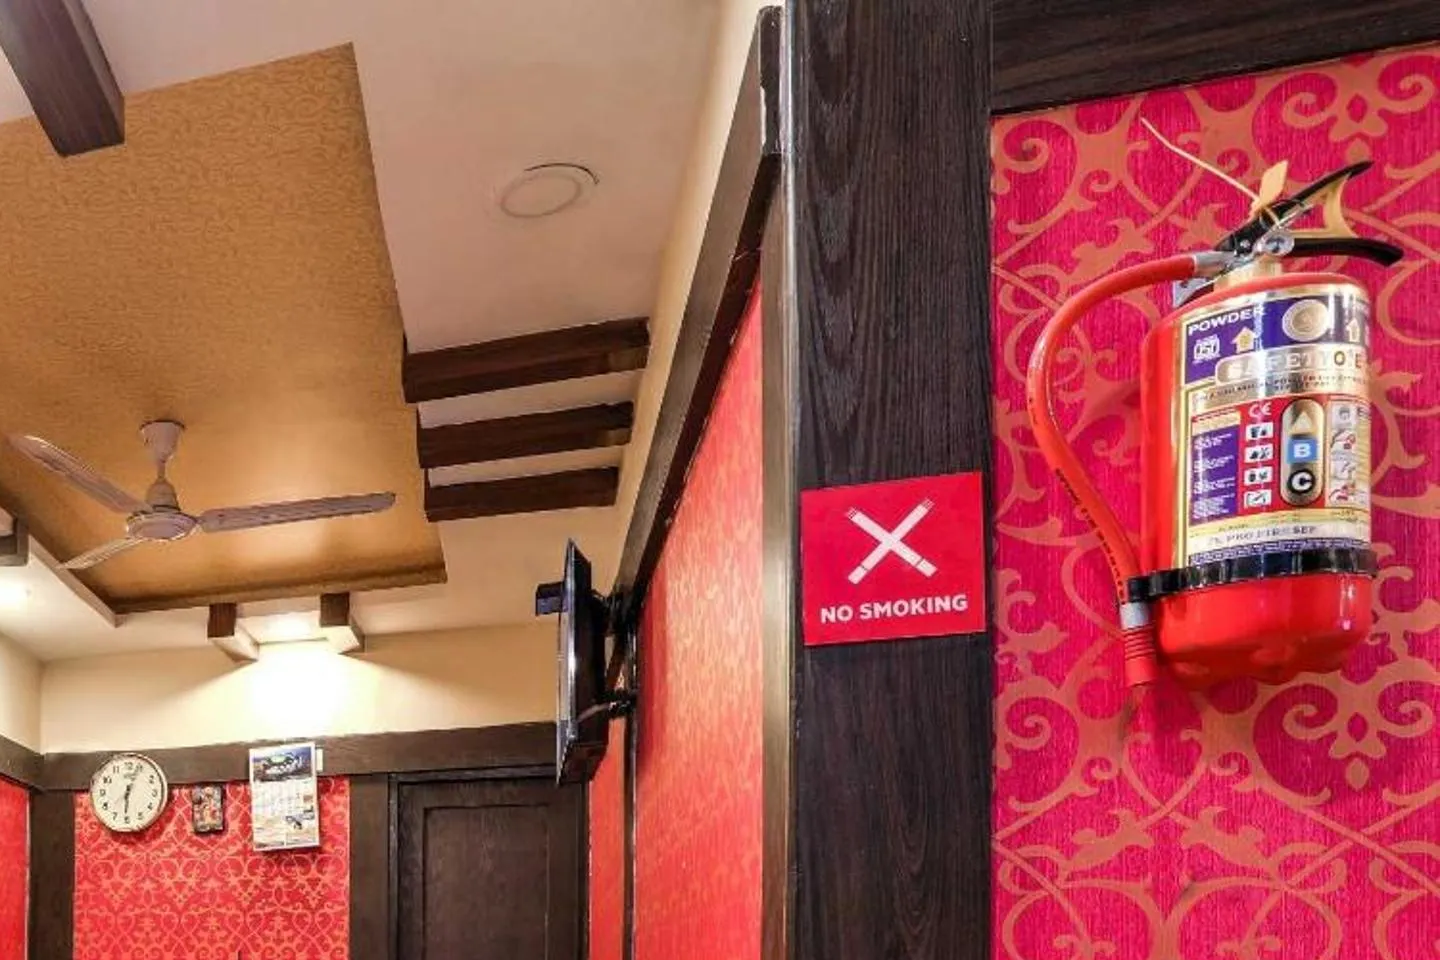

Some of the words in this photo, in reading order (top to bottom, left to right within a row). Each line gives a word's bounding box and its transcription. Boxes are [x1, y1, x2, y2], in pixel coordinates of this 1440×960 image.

[1188, 305, 1266, 335] POWDER
[1293, 443, 1312, 458] B
[1291, 472, 1312, 490] C
[820, 605, 853, 624] NO
[859, 594, 968, 620] SMOKING
